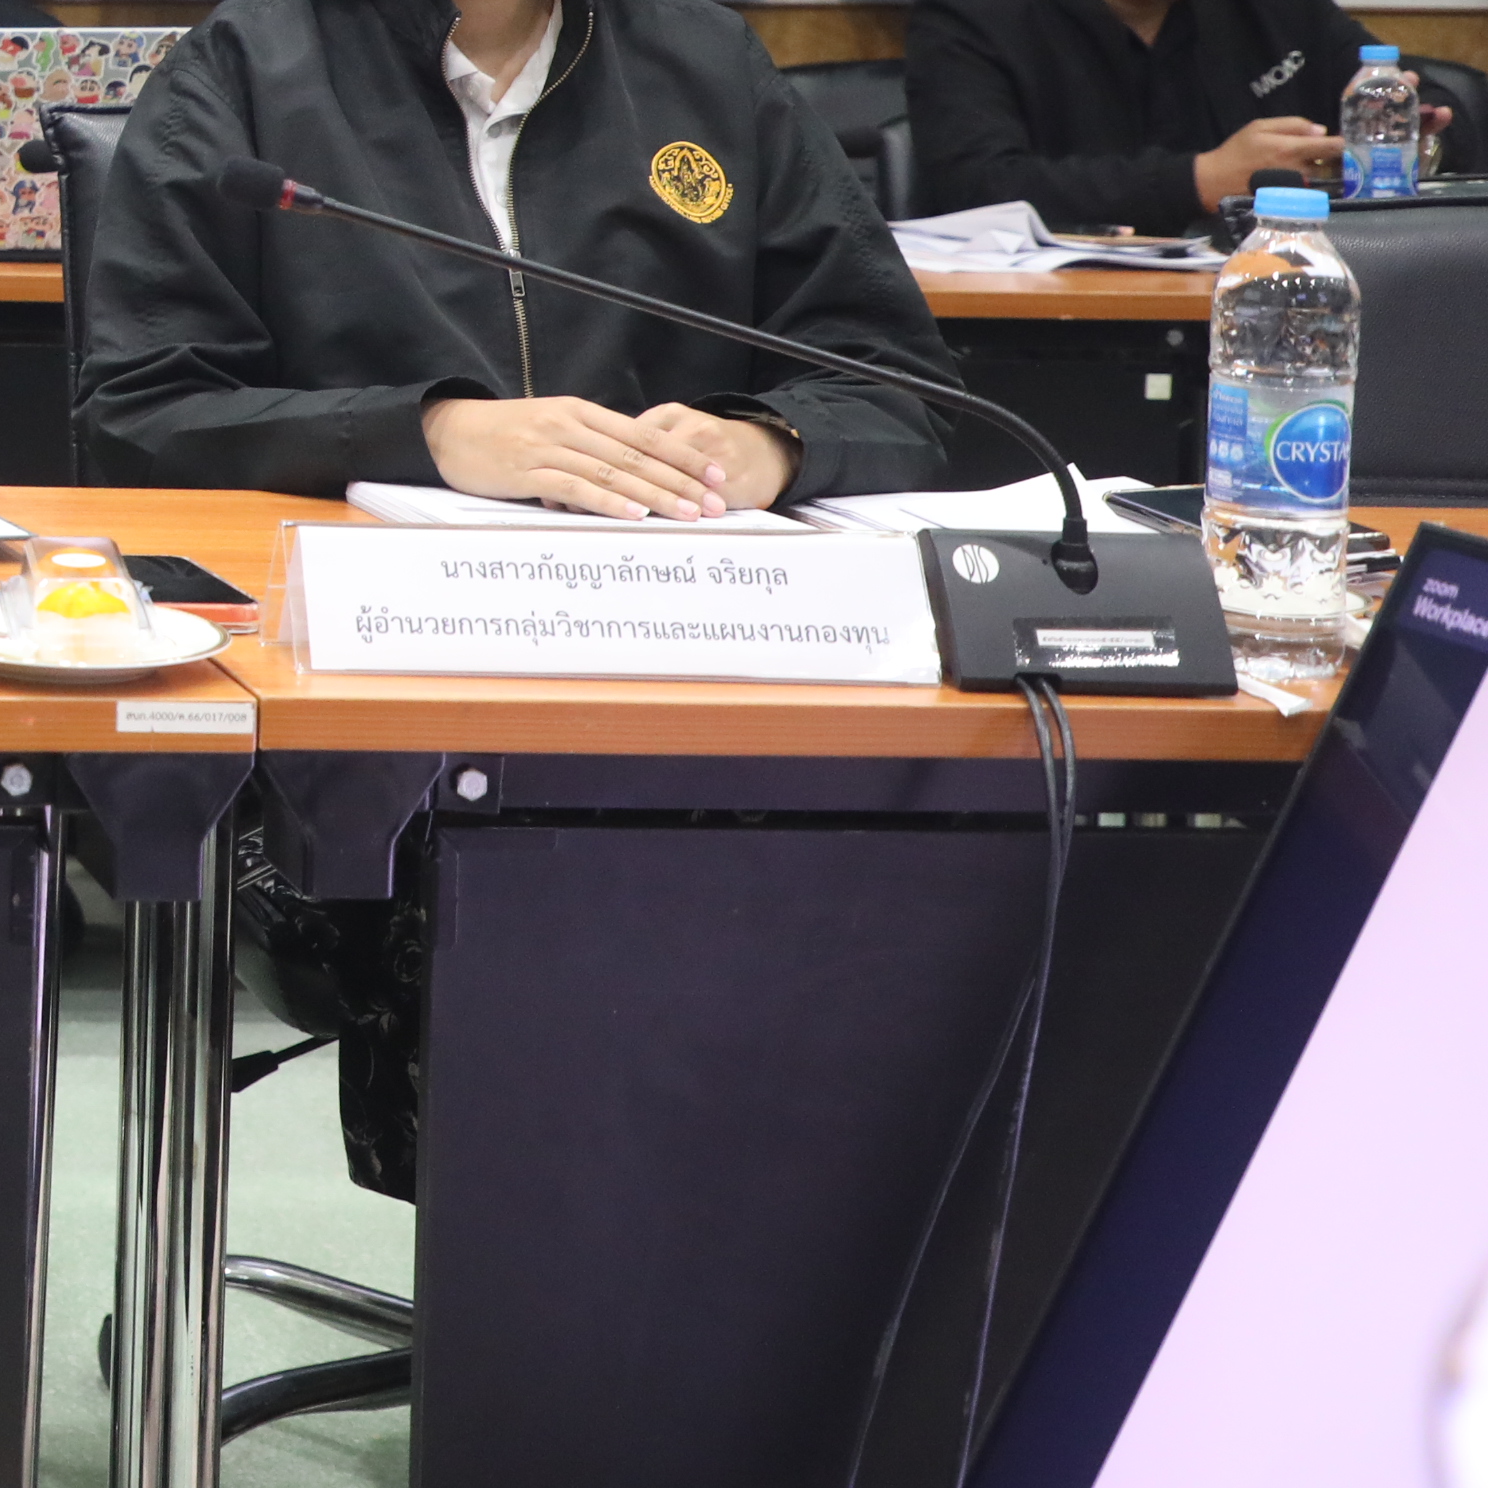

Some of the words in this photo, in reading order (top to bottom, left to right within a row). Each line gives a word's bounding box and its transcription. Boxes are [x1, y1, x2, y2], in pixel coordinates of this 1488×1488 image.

[1275, 440, 1350, 463] CRYSTA
[441, 552, 698, 590] นางสาวกัญญาลักษณ์
[706, 557, 789, 595] จริยกุล
[1423, 577, 1459, 600] zoom
[355, 606, 890, 655] ผู้อำนวยการกลุ่มวิชาการและแผนงานกองทุน
